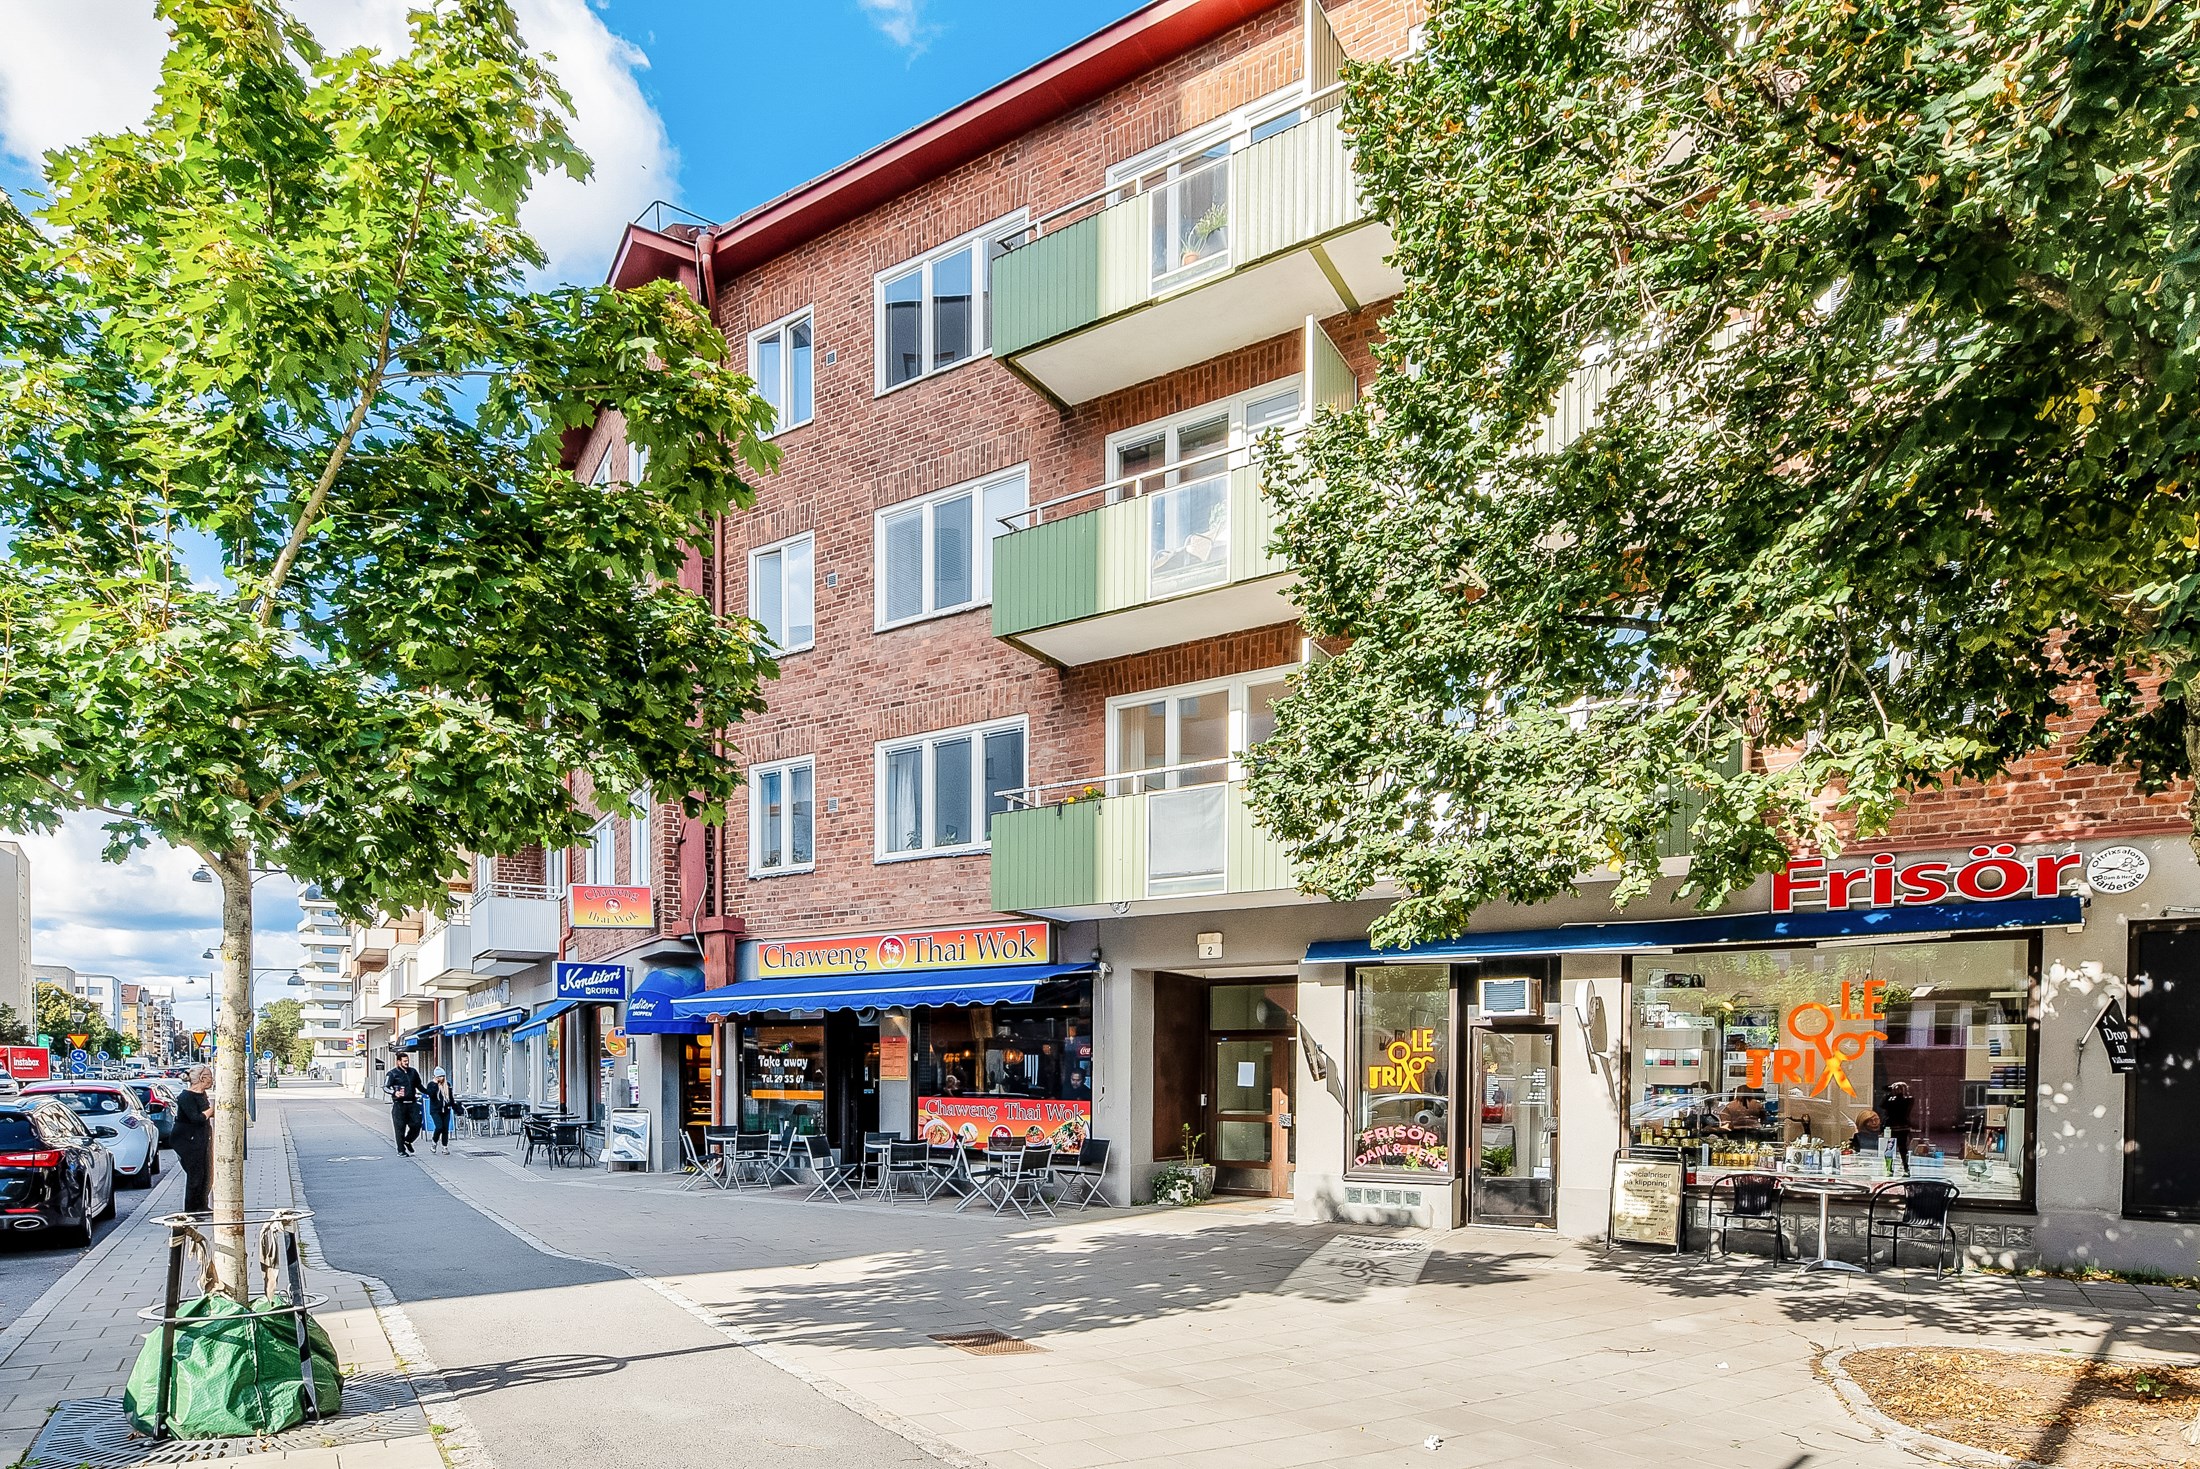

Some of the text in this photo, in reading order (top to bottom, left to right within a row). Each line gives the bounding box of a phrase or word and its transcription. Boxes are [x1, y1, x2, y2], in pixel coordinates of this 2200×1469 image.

[1771, 843, 2083, 914] Frisör
[2092, 873, 2144, 891] Barberare
[584, 888, 639, 902] Chaweng
[588, 911, 639, 923] Thai Wok
[763, 930, 1037, 971] Chaweng Thai Wok
[1207, 946, 1213, 956] 2
[560, 967, 621, 991] Konditori
[585, 987, 619, 995] DROPPEN
[2103, 1028, 2128, 1043] Drop
[2115, 1041, 2127, 1054] in
[758, 1055, 808, 1070] Take away
[784, 1074, 794, 1083] 55
[925, 1100, 1086, 1122] Chaweng Thai Wok
[1362, 1125, 1439, 1147] FRISÖR
[1354, 1144, 1390, 1168] DAM
